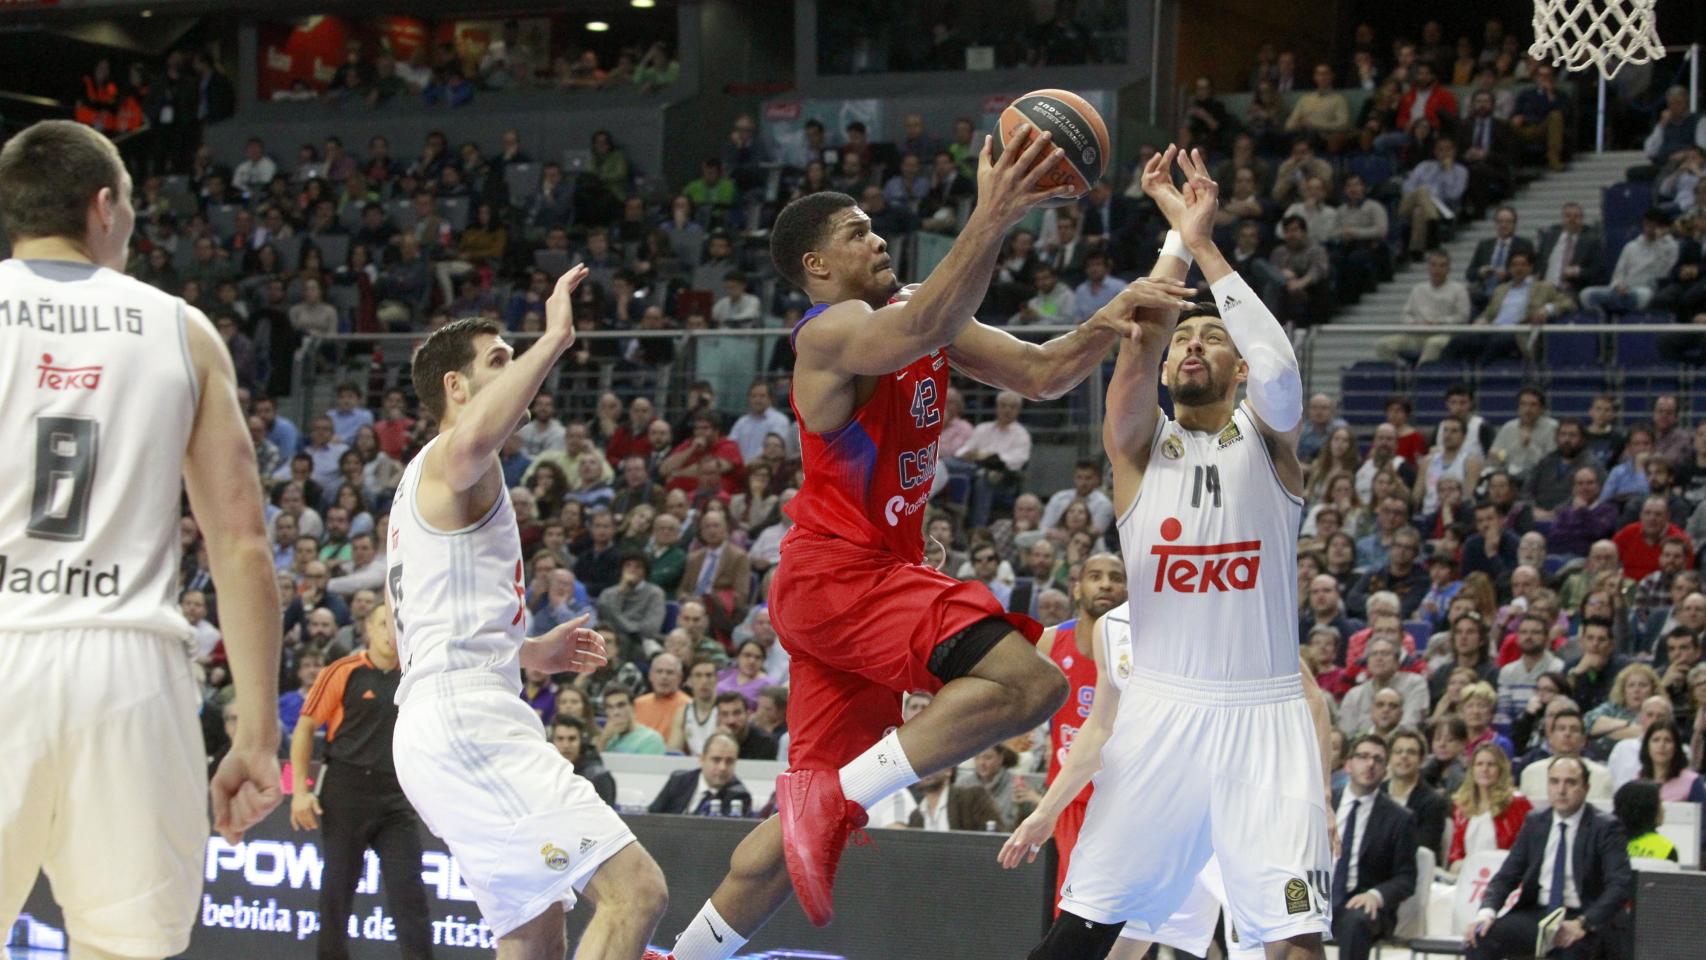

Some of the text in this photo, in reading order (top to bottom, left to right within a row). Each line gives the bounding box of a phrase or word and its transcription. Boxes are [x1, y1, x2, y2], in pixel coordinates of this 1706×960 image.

[1036, 101, 1089, 145] EUROLEAGUE
[37, 353, 103, 390] Teka
[910, 377, 941, 428] 42
[26, 416, 99, 541] 8
[899, 438, 939, 490] CSK
[1191, 464, 1222, 508] 14
[1150, 517, 1261, 593] Teka
[202, 894, 293, 933] bebida
